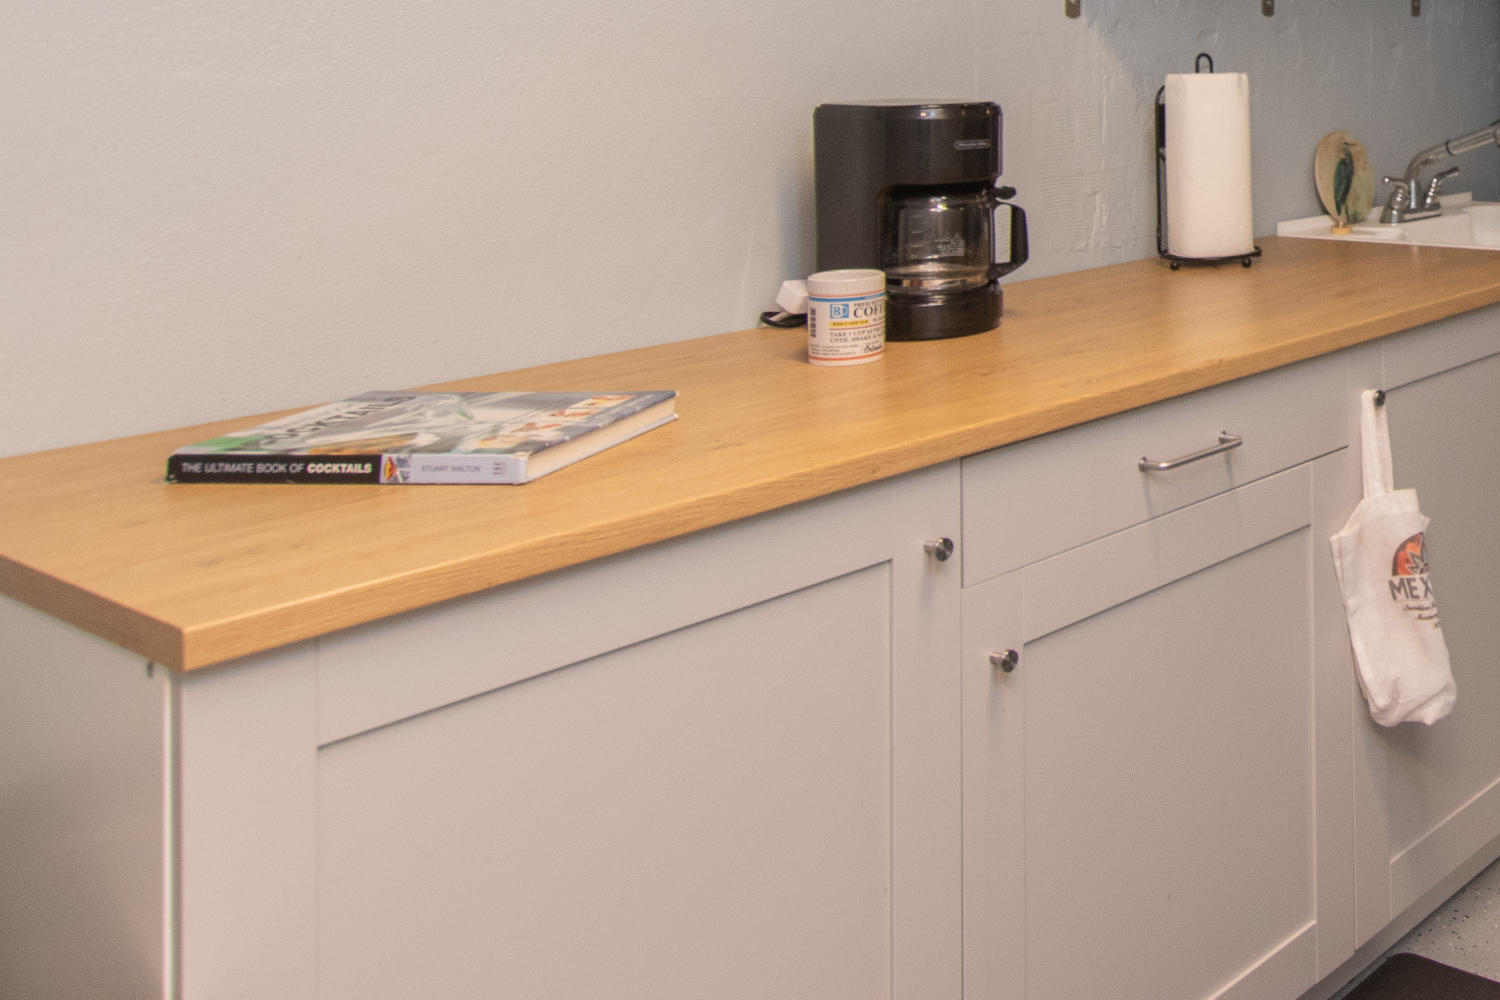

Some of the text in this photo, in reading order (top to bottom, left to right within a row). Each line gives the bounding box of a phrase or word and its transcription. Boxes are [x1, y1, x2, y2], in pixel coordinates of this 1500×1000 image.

[182, 462, 373, 474] THE ULTIMATE BOOK OF COCKTAILS
[421, 465, 481, 473] STUART WALTON
